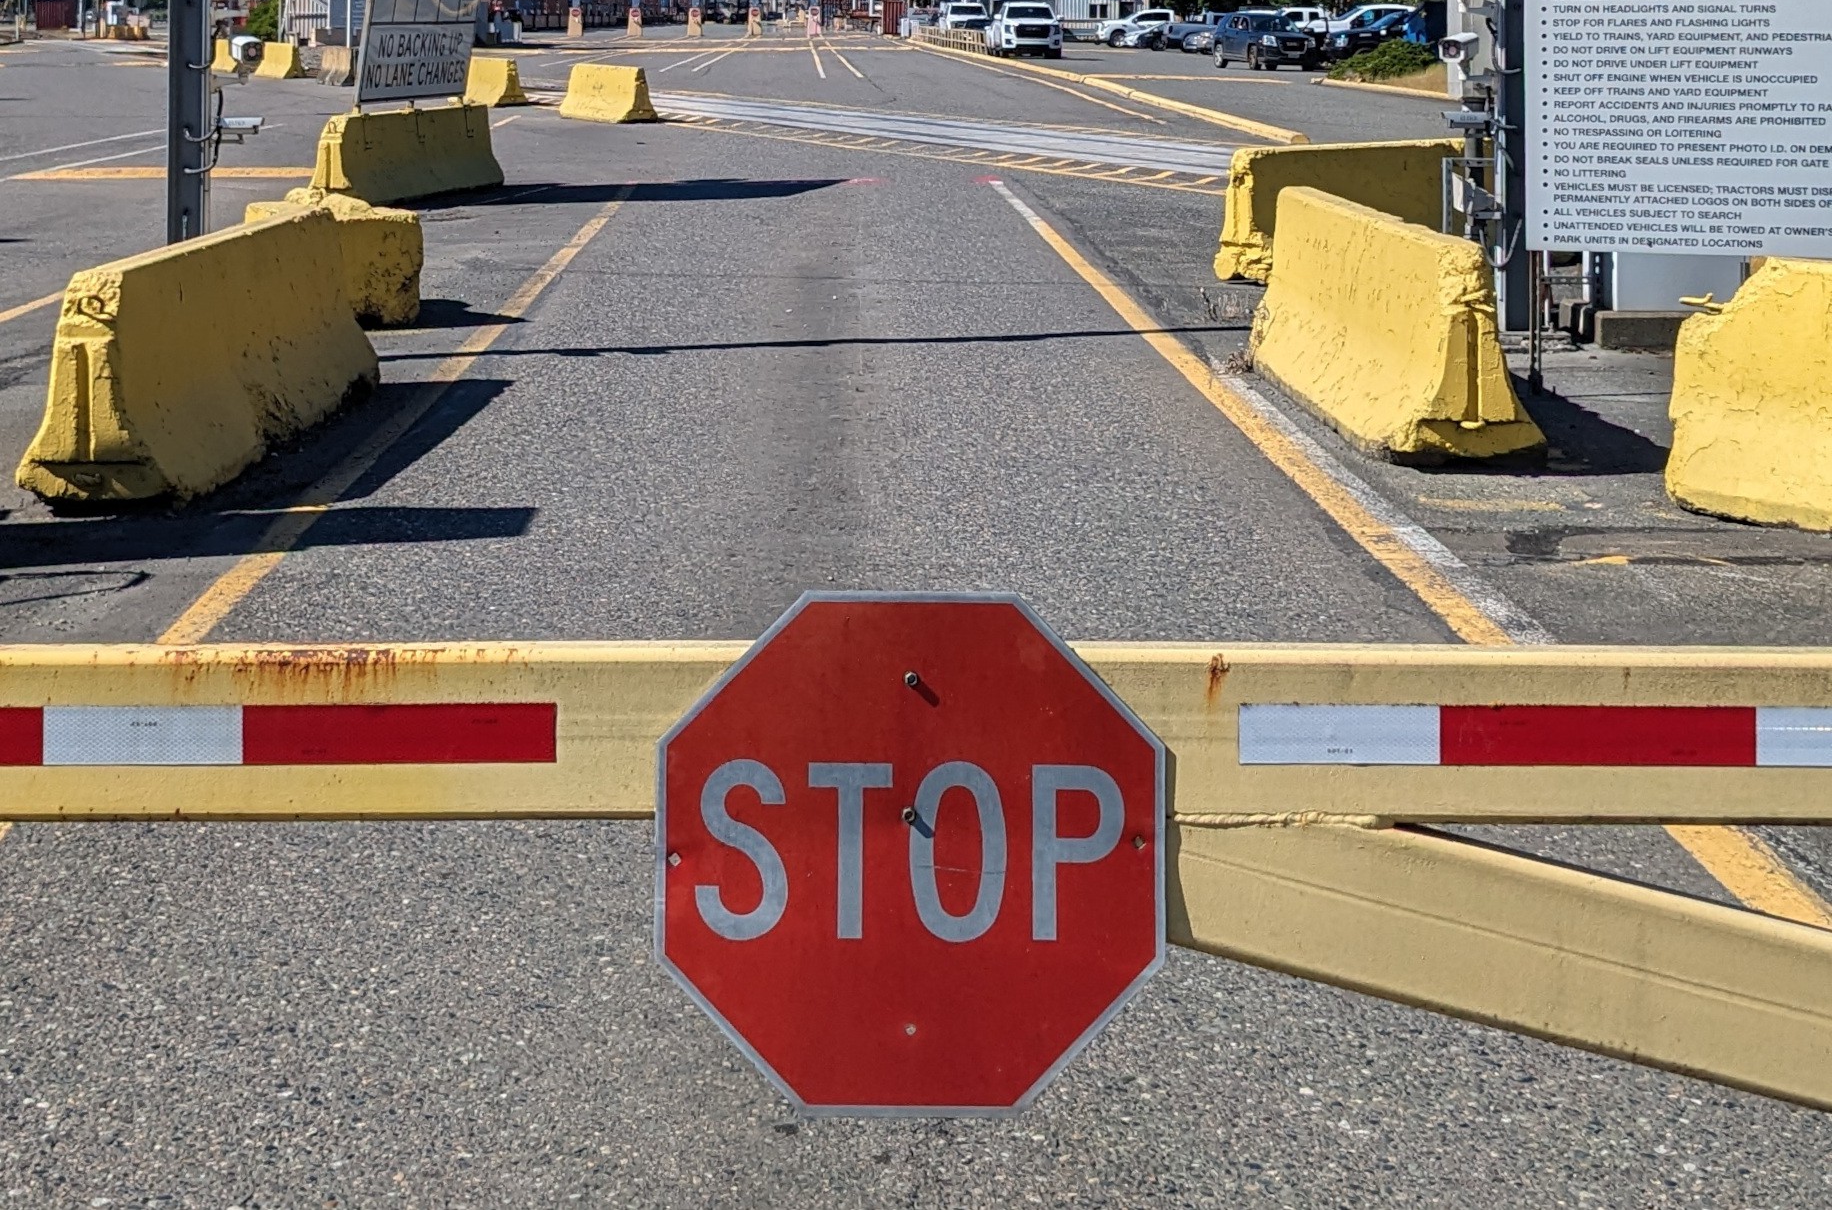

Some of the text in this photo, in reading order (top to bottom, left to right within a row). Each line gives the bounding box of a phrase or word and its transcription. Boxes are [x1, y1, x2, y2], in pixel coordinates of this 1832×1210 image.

[1554, 4, 1777, 14] TURN ON HEADLIGHTS AND SIGNAL TURNS
[1553, 18, 1771, 28] STOP FOR FLARES AND FLASHING LIGHTS
[1554, 32, 1583, 41] YIELD
[1586, 32, 1601, 41] TO
[1604, 32, 1644, 43] TRAINS,
[1647, 32, 1675, 41] YARD
[1678, 33, 1744, 44] EQUIPMENT,
[1746, 32, 1770, 41] AND
[378, 32, 464, 58] NO BACKING UP
[1553, 45, 1793, 55] DO NOT DRIVE ON LIFT EQUIPMENT RUNWAYS
[1554, 59, 1759, 69] DO NOT DRIVE UNDER LIFT EQUIPMENT
[366, 60, 466, 90] NO LANE CHANGES
[1554, 73, 1818, 84] SHUT OFF ENGINE WHEN VEHICLE IS UNOCCUPIED
[1554, 87, 1769, 97] KEEP OFF TRAINS AND YARD EQUIPMENT
[1554, 101, 1596, 110] REPORT
[1598, 101, 1660, 110] ACCIDENTS
[1661, 101, 1685, 110] AND
[1688, 102, 1736, 111] INJURIES
[1739, 103, 1798, 112] PROMPTLY
[1800, 103, 1816, 112] TO
[1554, 114, 1827, 126] ALCOHOL, DRUGS, AND FIREARMS ARE PROHIBITED
[1554, 127, 1722, 138] NO TRESPASSING OR LOITERING
[1554, 141, 1577, 150] YOU
[1579, 141, 1600, 150] ARE
[1603, 142, 1658, 151] REQUIRED
[1661, 143, 1675, 152] TO
[1678, 143, 1727, 152] PRESENT
[1730, 144, 1768, 153] PHOTO
[1791, 144, 1807, 153] ON
[1810, 145, 1832, 154] DEM
[1555, 155, 1829, 168] DO NOT BREAK SEALS UNLESS REQUIRED FOR GATE
[1555, 168, 1627, 178] NO LITTERING
[1555, 182, 1605, 191] VEHICLES
[1608, 184, 1638, 193] MUST
[1641, 183, 1655, 192] BE
[1658, 185, 1714, 196] LICENSED;
[1717, 186, 1775, 195] TRACTORS
[1778, 187, 1808, 196] MUST
[1554, 194, 1630, 203] PERMANENTLY
[1633, 196, 1689, 205] ATTACHED
[1692, 197, 1730, 206] LOGOS
[1733, 197, 1748, 206] ON
[1751, 198, 1781, 207] BOTH
[1784, 199, 1816, 208] SIDES
[1554, 207, 1742, 220] ALL VEHICLES SUBJECT TO SEARCH
[1554, 221, 1624, 230] UNATTENDED
[1627, 223, 1678, 232] VEHICLES
[1681, 224, 1707, 233] WILL
[1710, 224, 1724, 233] BE
[1727, 225, 1766, 234] TOWED
[1769, 227, 1783, 236] AT
[1554, 235, 1763, 248] PARK UNITS IN DESIGNATED LOCATIONS
[694, 758, 1126, 944] STOP
